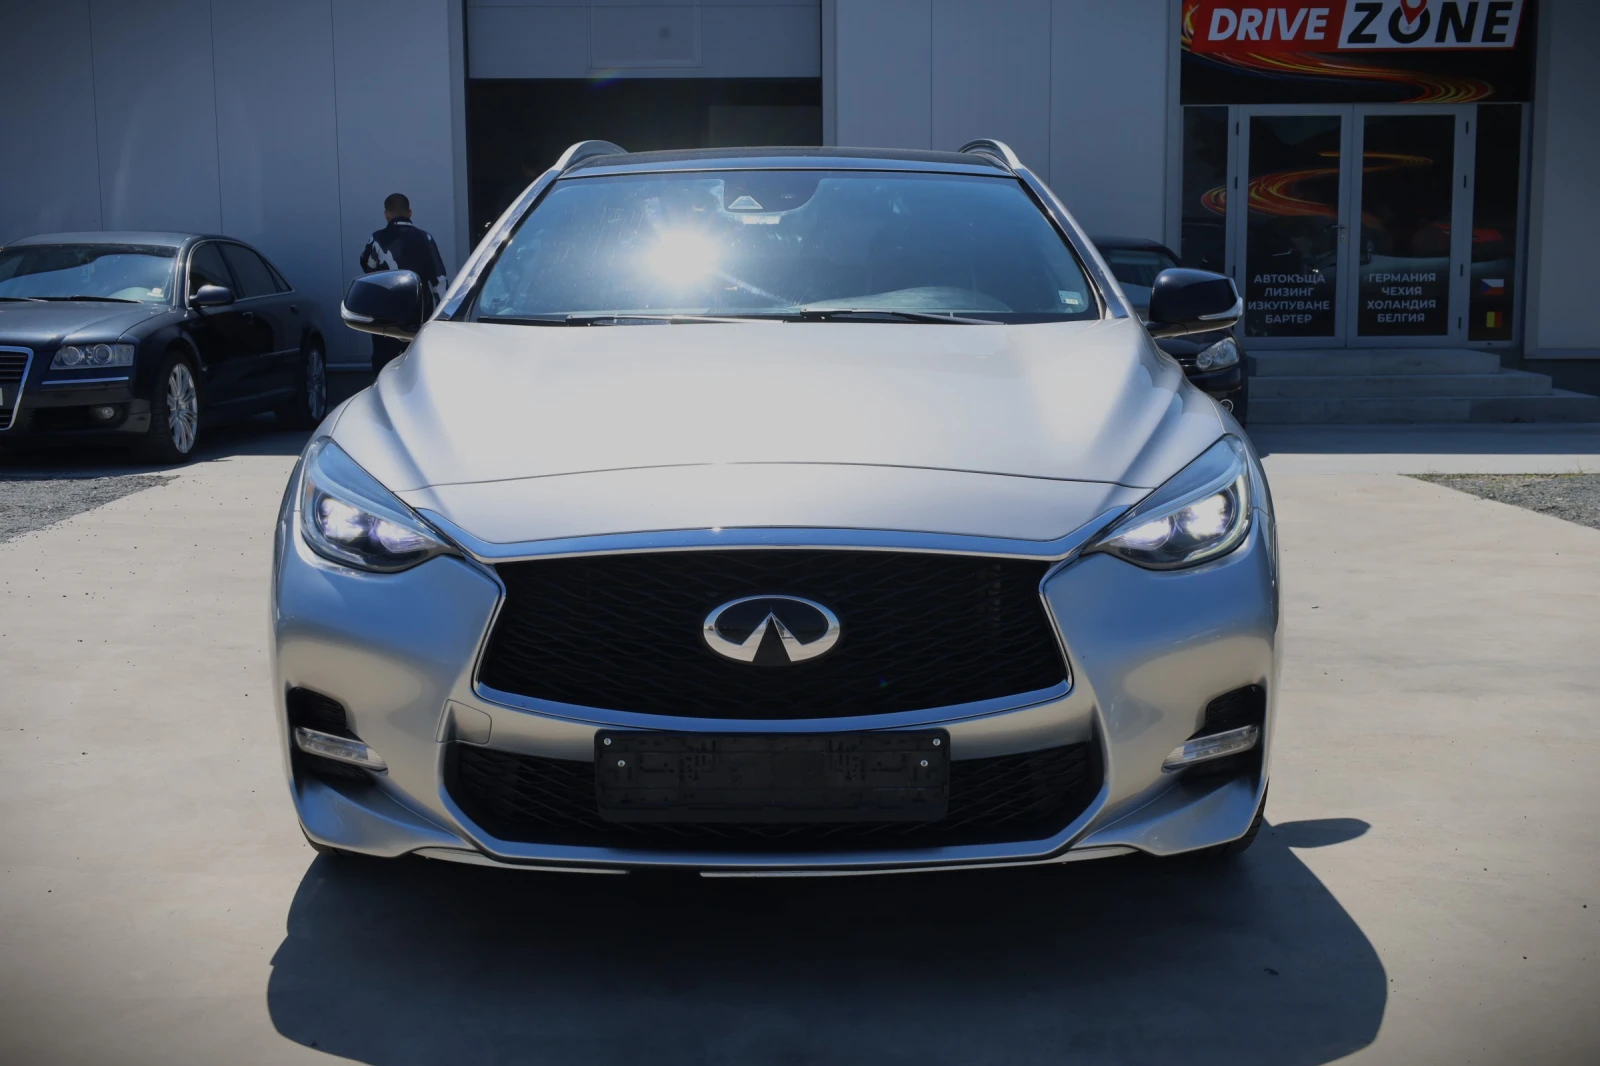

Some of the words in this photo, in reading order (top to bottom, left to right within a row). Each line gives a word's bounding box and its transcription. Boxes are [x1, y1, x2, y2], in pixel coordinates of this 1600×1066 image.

[1207, 8, 1330, 41] DRIVE
[1347, 1, 1514, 43] ZONE
[1254, 274, 1325, 284] АВТОКЪЩА
[1369, 273, 1436, 282] ГЕРМАНИЯ
[1264, 287, 1314, 297] ЛИЗИНГ
[1381, 286, 1422, 296] ЧЕХИЯ
[1248, 300, 1330, 310] ИЗКУПУВАНЕ
[1367, 299, 1436, 310] ХОЛАНДИЯ
[1265, 314, 1312, 324] БАРТЕР
[1377, 313, 1425, 323] БЕЛГИЯ
